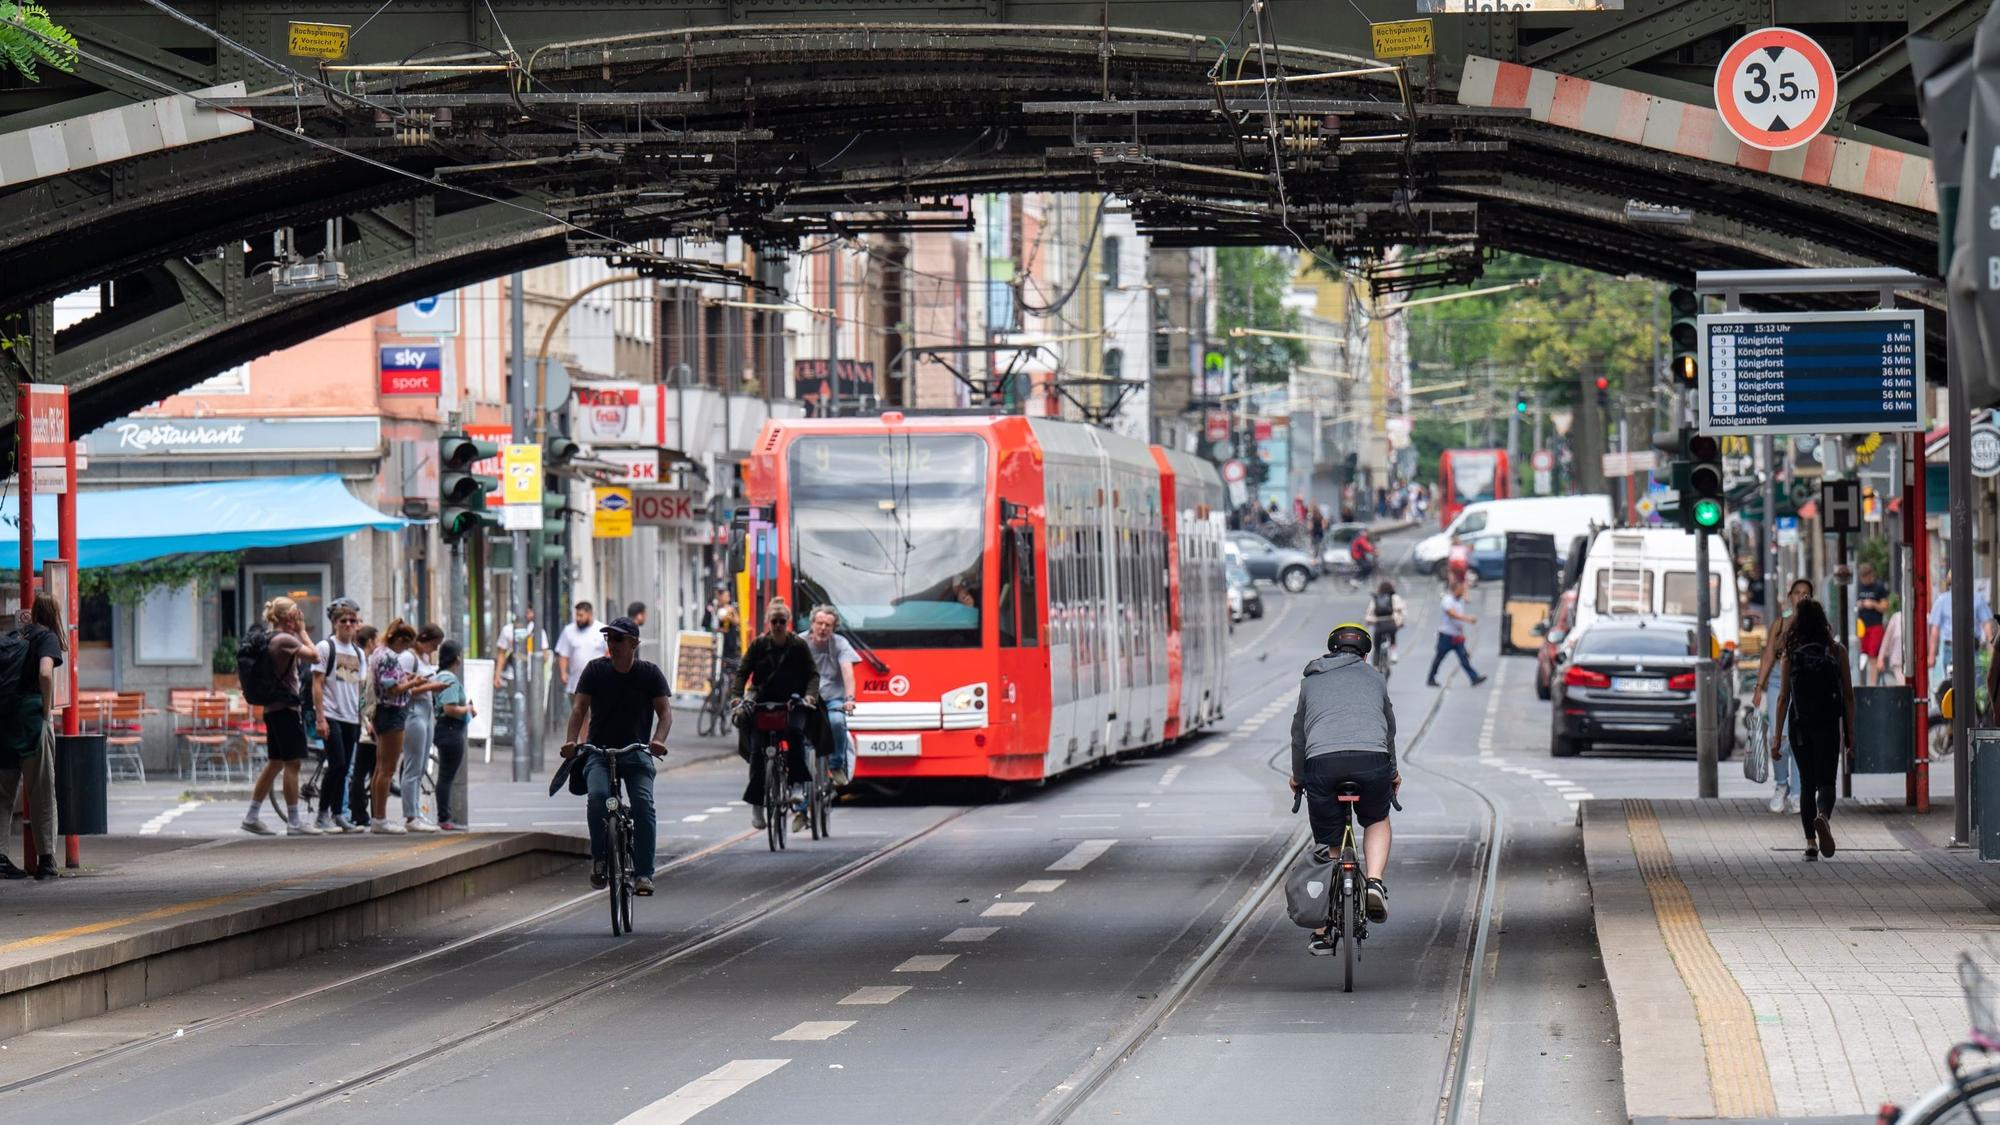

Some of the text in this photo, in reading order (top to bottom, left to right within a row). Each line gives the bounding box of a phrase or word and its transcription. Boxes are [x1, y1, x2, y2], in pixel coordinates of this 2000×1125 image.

[294, 27, 344, 39] Hochspannung
[1376, 26, 1426, 36] Hochspannung
[298, 45, 338, 54] Lebensgefahr
[1383, 43, 1423, 52] Lebensgefahr
[1711, 322, 1911, 334] 08.07.22 15:12 Uhr in
[1720, 333, 1911, 346] 9 Königsforst 8 Min
[1720, 344, 1911, 357] 9 Königsforst 16 Min
[395, 349, 426, 369] sky
[1737, 358, 1783, 369] Königsforst
[1882, 356, 1892, 365] 26
[1894, 356, 1911, 365] Min
[1721, 367, 1911, 380] 9 Königsforst 36 Min
[392, 376, 429, 390] sport
[1721, 379, 1911, 391] 9 Königsforst 46 Min
[1721, 390, 1912, 403] 9 Königsforst 56 Min
[1722, 401, 1912, 414] 9 Königsforst 66 Min
[117, 423, 245, 449] Restaurant
[816, 443, 829, 472] 9
[634, 497, 691, 519] IOSK
[1823, 485, 1858, 528] H
[863, 680, 888, 691] KVB
[870, 741, 903, 751] 4034
